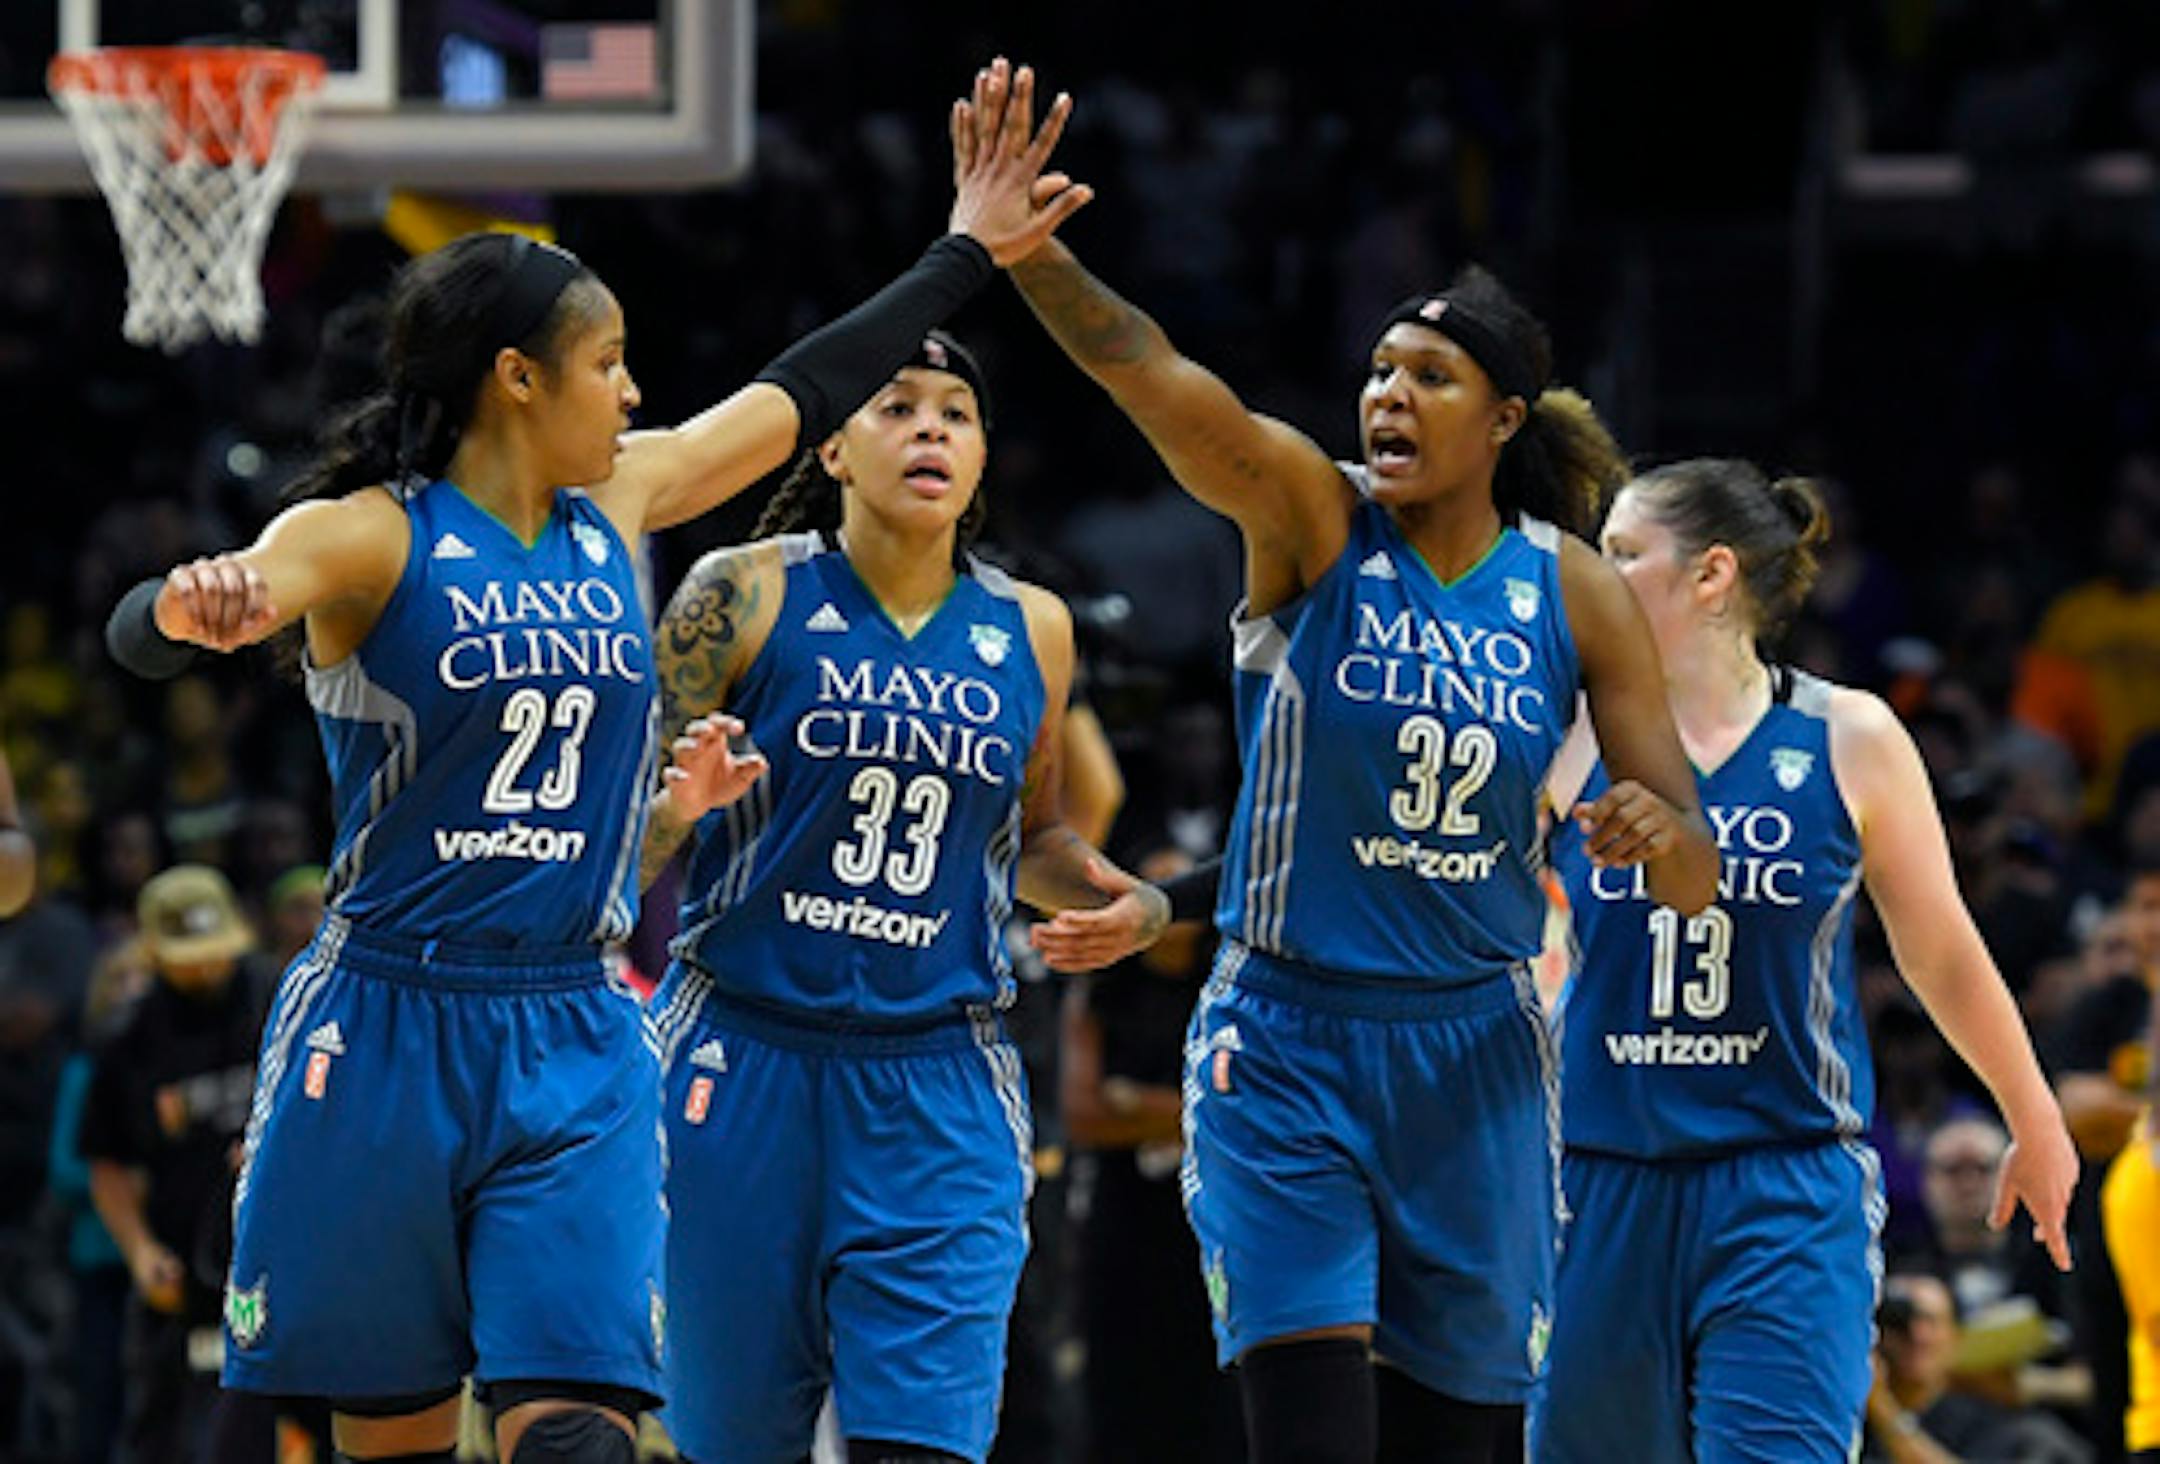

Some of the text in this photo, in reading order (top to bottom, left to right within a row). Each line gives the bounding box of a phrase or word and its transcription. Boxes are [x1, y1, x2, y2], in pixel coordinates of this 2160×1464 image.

[445, 578, 623, 631] MAYO
[1357, 603, 1532, 677] MAYO
[438, 629, 644, 689] CLINIC
[816, 655, 1000, 723] MAYO
[1336, 654, 1544, 734] CLINIC
[483, 685, 596, 813] 23
[797, 710, 1011, 783] CLINIC
[1389, 714, 1497, 835] 32
[832, 766, 949, 895] 33
[1706, 806, 1792, 851] YO
[783, 892, 950, 947] verizon
[1648, 904, 1732, 1019] 13
